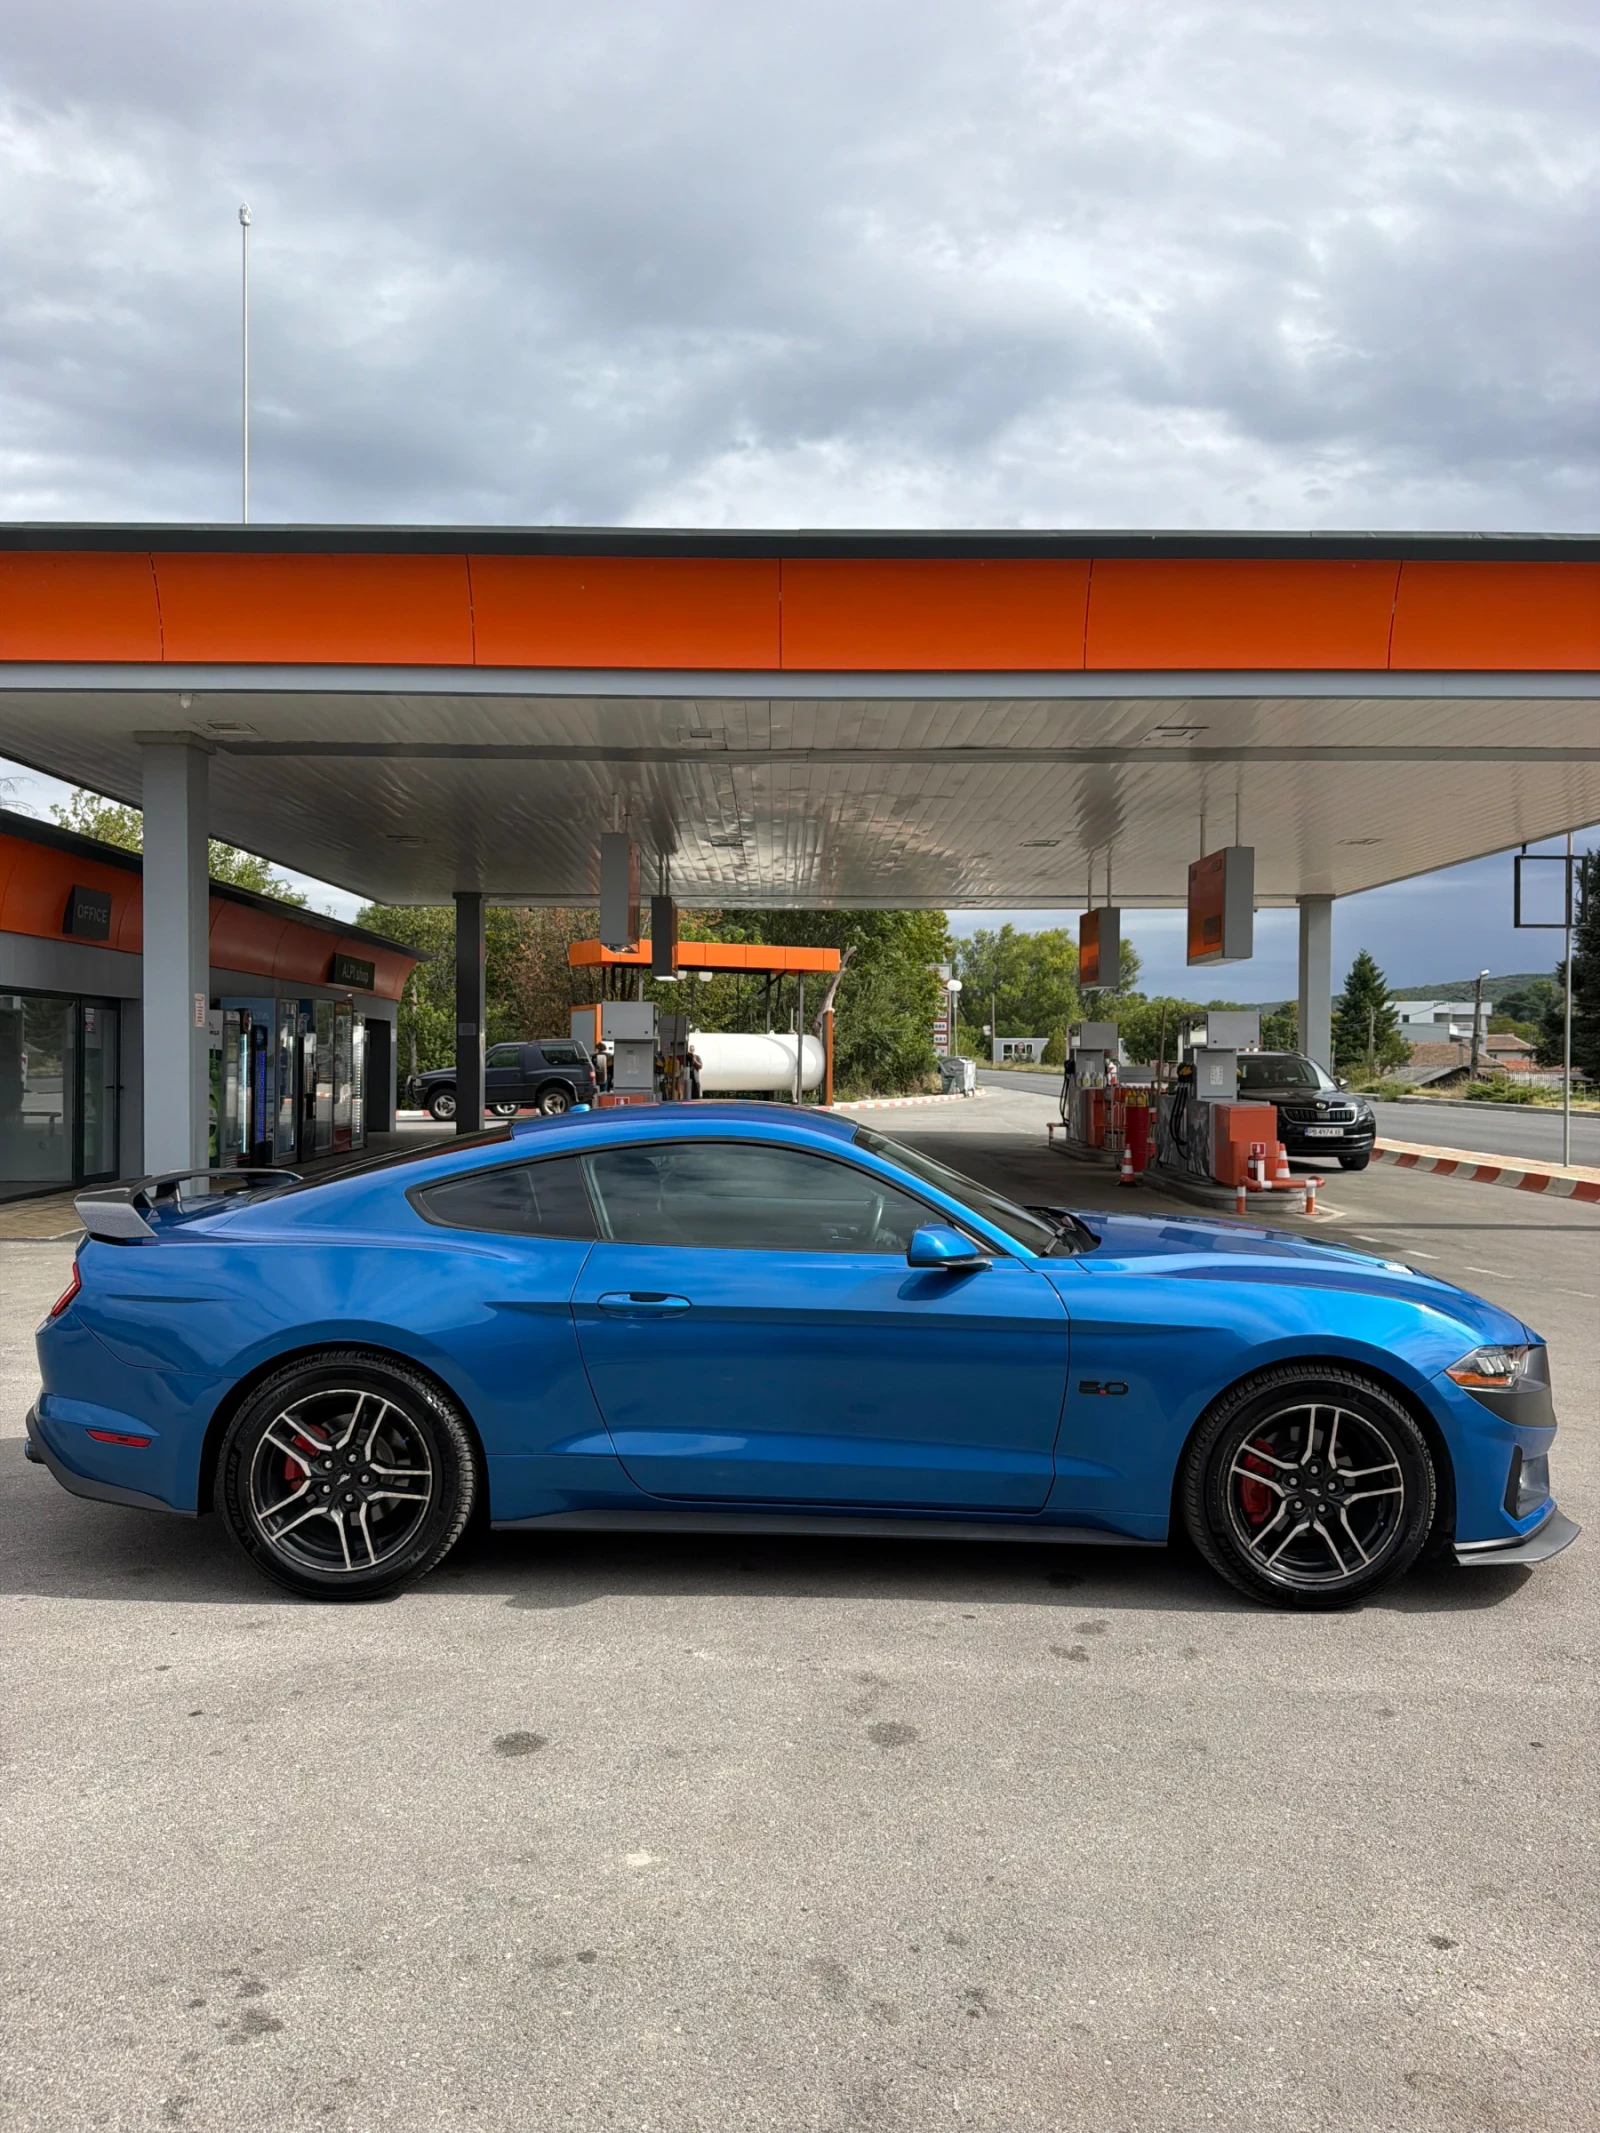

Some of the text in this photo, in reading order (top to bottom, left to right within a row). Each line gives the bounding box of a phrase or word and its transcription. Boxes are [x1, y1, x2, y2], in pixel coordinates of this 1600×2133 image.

[77, 904, 109, 924] OFFICE
[356, 965, 369, 985] shop
[1079, 1380, 1129, 1396] 5.0
[225, 1452, 244, 1528] MICHELIN
